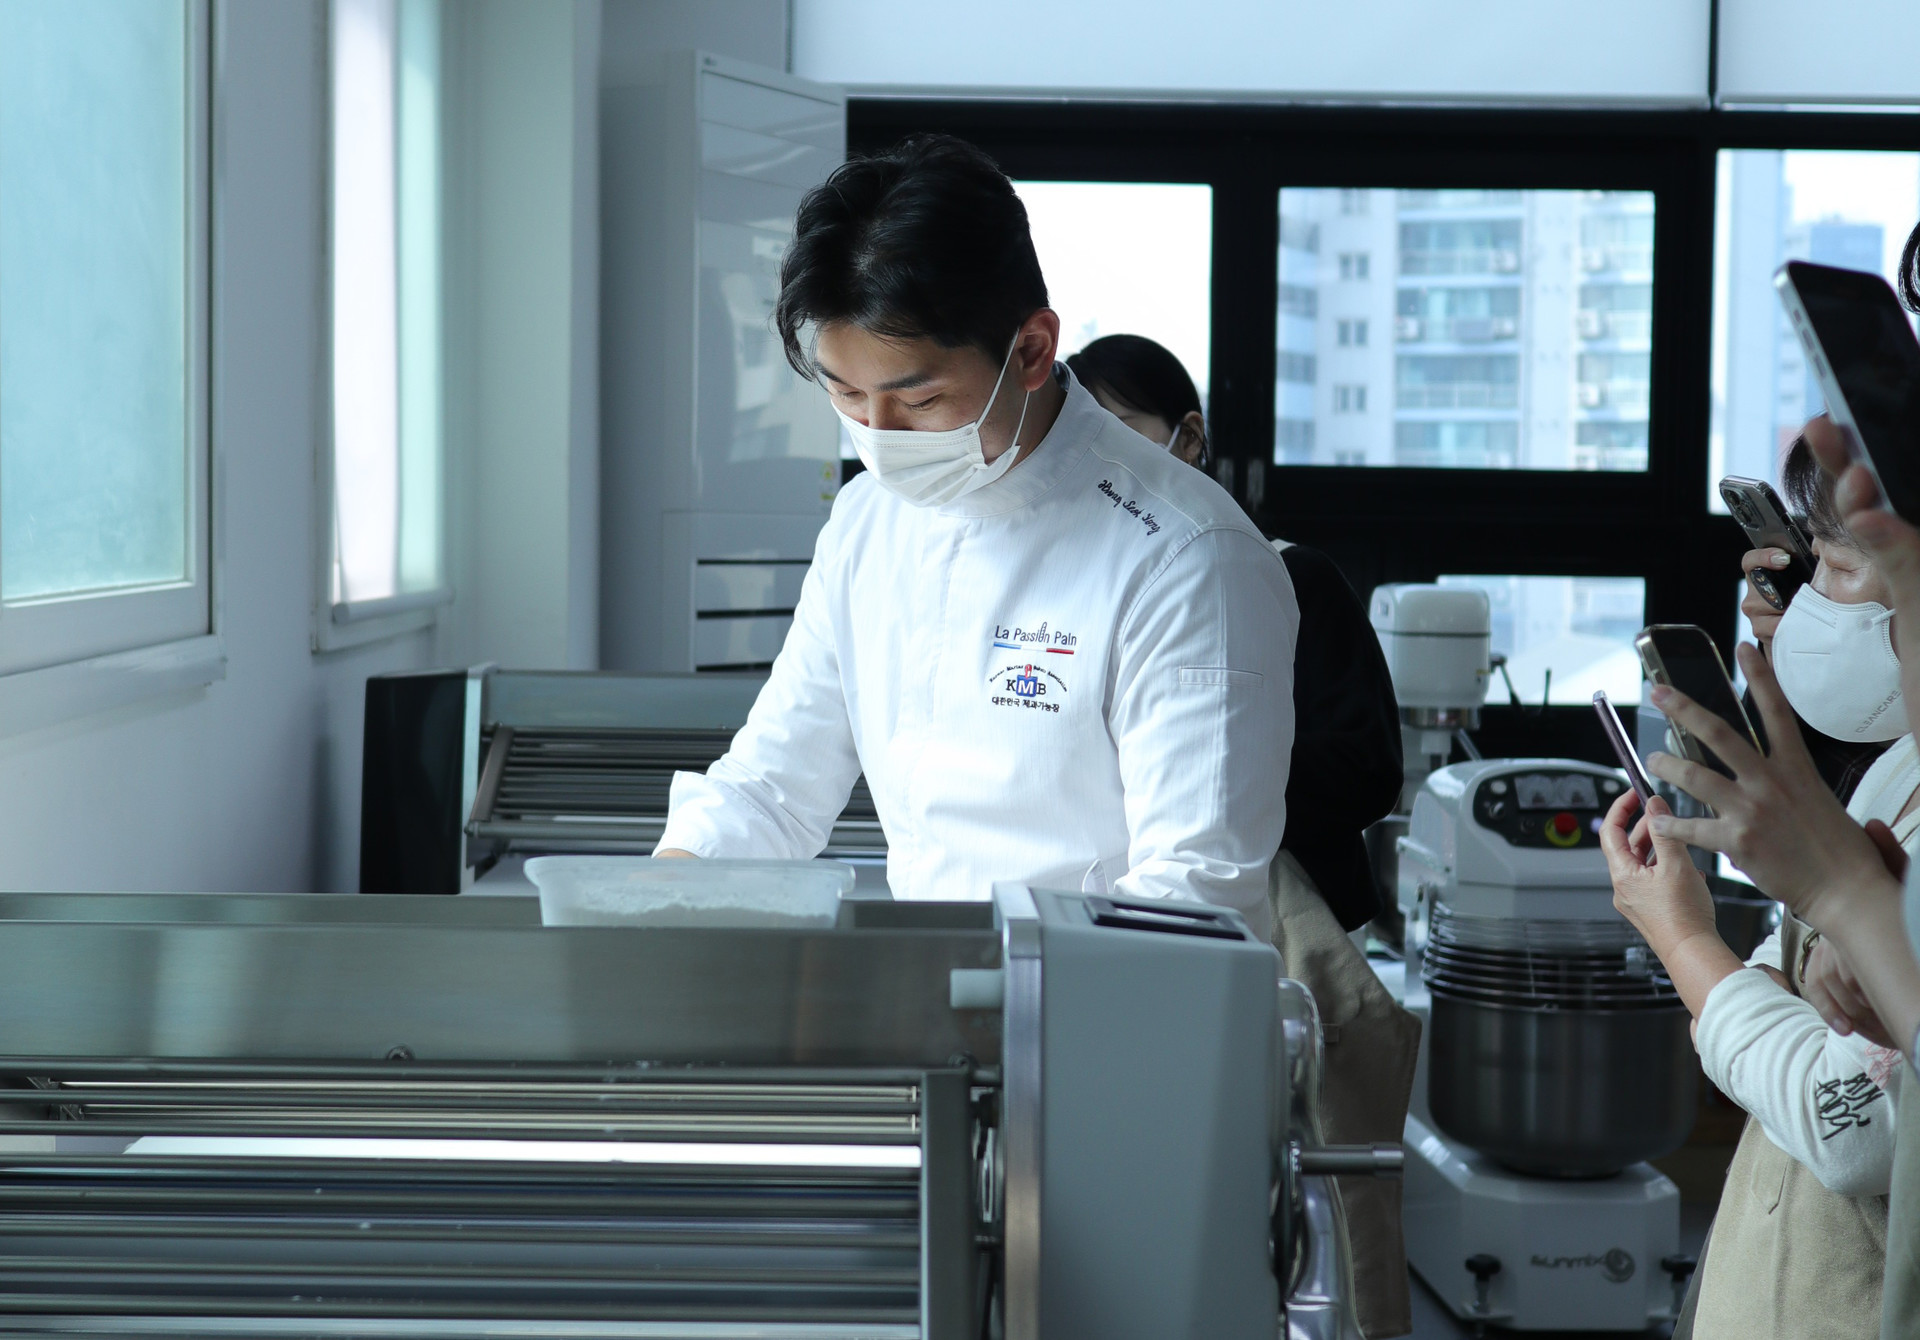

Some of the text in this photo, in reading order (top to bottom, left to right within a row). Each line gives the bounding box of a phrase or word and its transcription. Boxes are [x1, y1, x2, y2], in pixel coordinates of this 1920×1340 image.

[995, 625, 1010, 640] La
[1013, 621, 1051, 644] Passion
[1005, 678, 1047, 696] KMB
[1855, 690, 1902, 734] CLEANCARE
